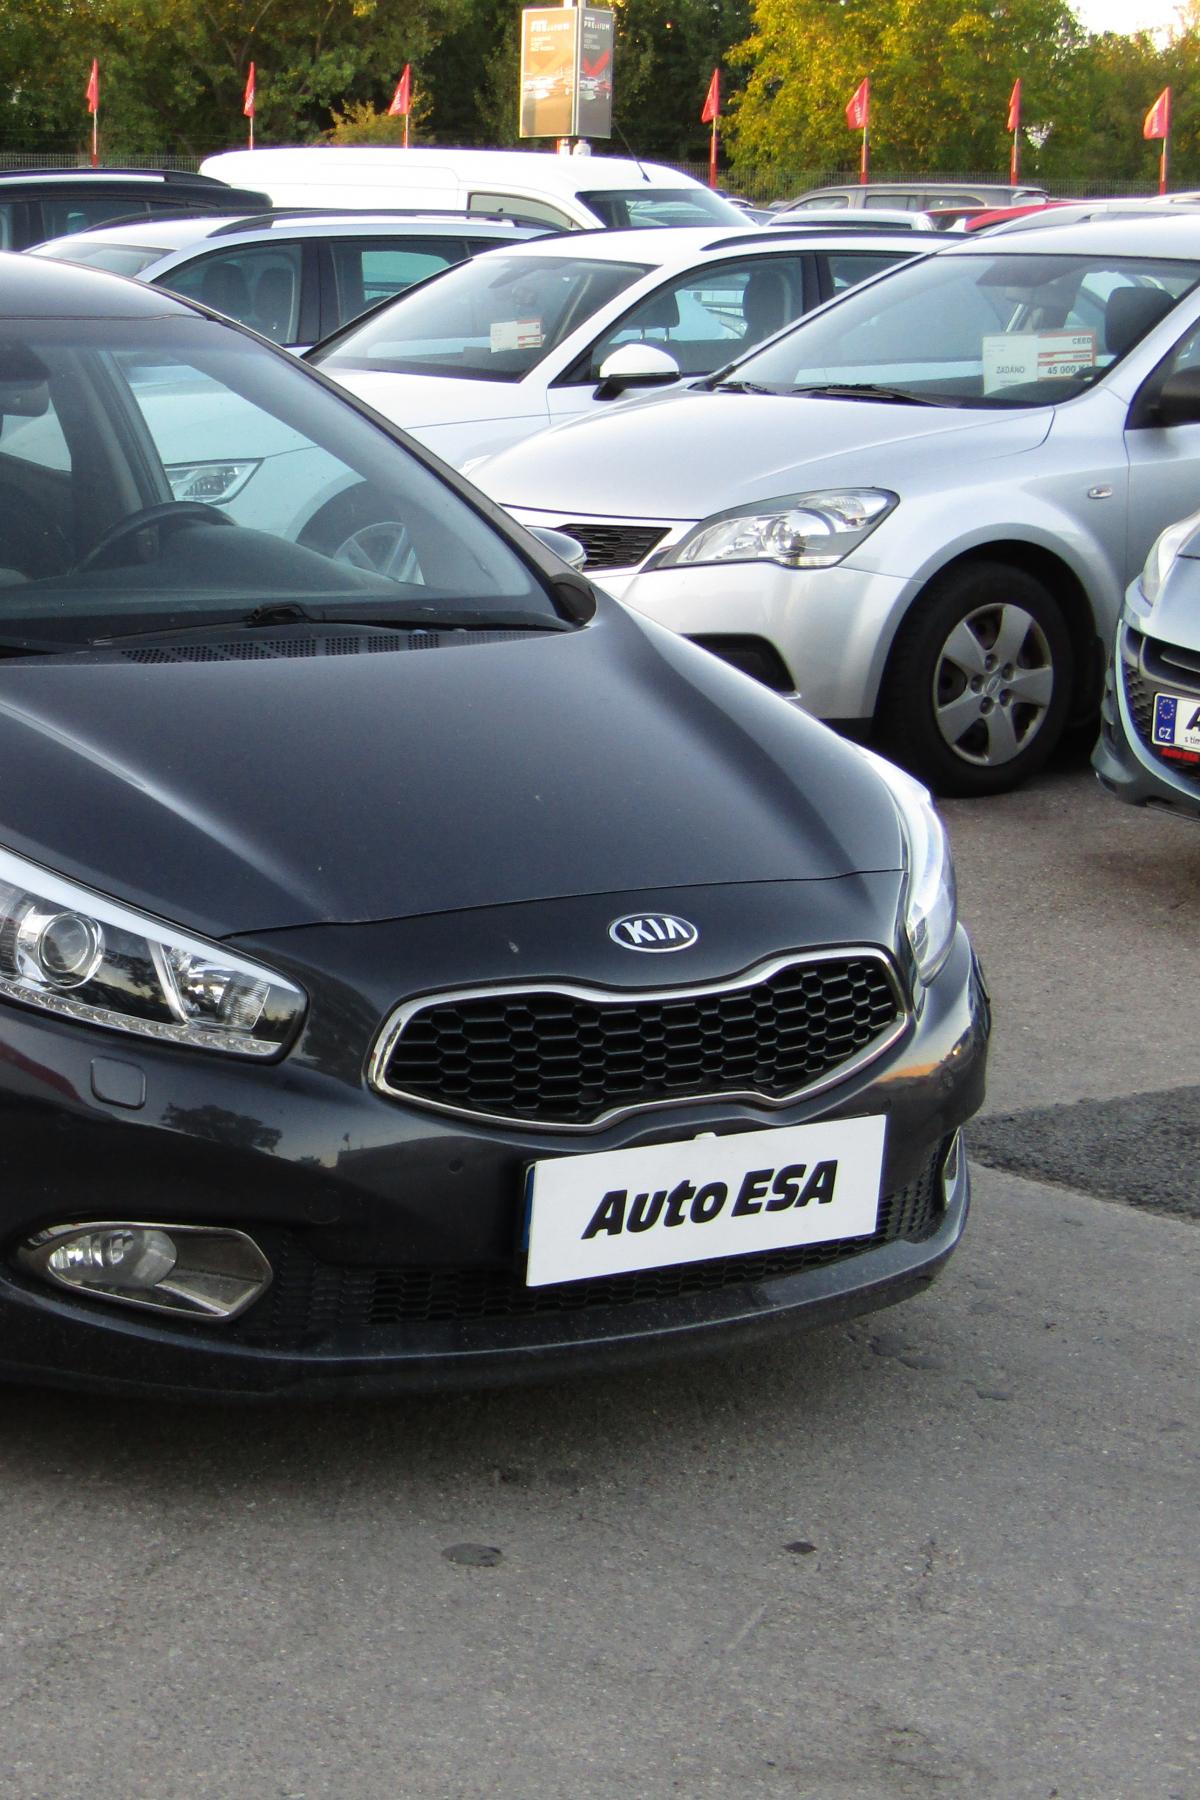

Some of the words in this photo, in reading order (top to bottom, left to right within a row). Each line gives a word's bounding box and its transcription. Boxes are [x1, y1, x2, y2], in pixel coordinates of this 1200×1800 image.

[1158, 726, 1171, 740] CZ
[620, 917, 690, 944] KIA
[581, 1179, 728, 1240] Auto
[731, 1159, 838, 1217] ESA
